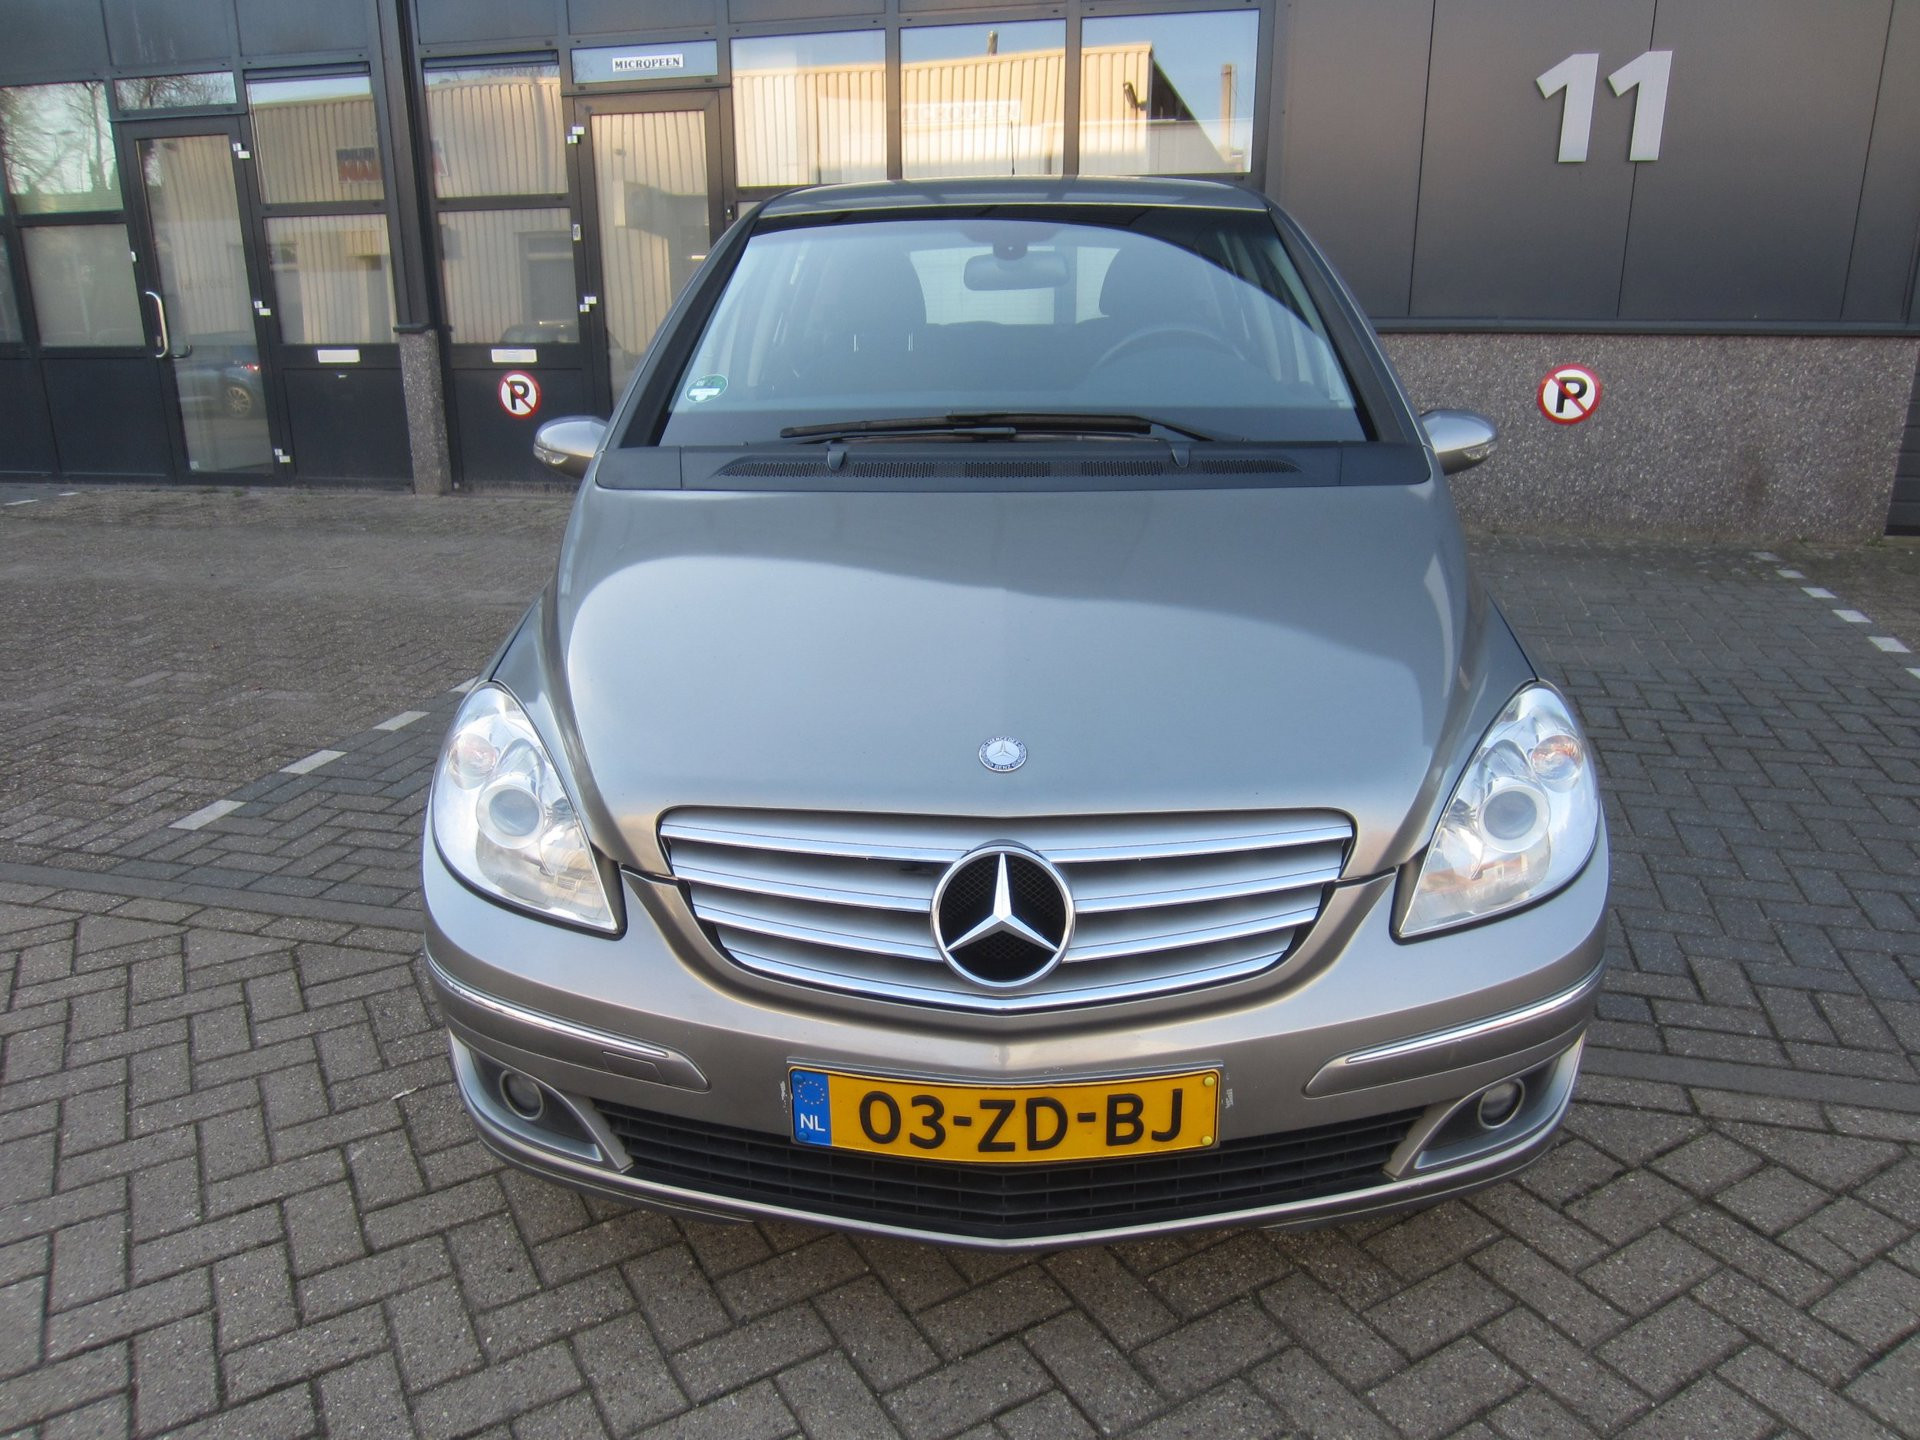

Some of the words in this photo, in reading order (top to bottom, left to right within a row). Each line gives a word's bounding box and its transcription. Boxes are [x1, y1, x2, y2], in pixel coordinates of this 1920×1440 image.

[1535, 50, 1673, 162] 11
[800, 1113, 826, 1132] NL
[859, 1088, 1183, 1152] 03-ZD-BJ
